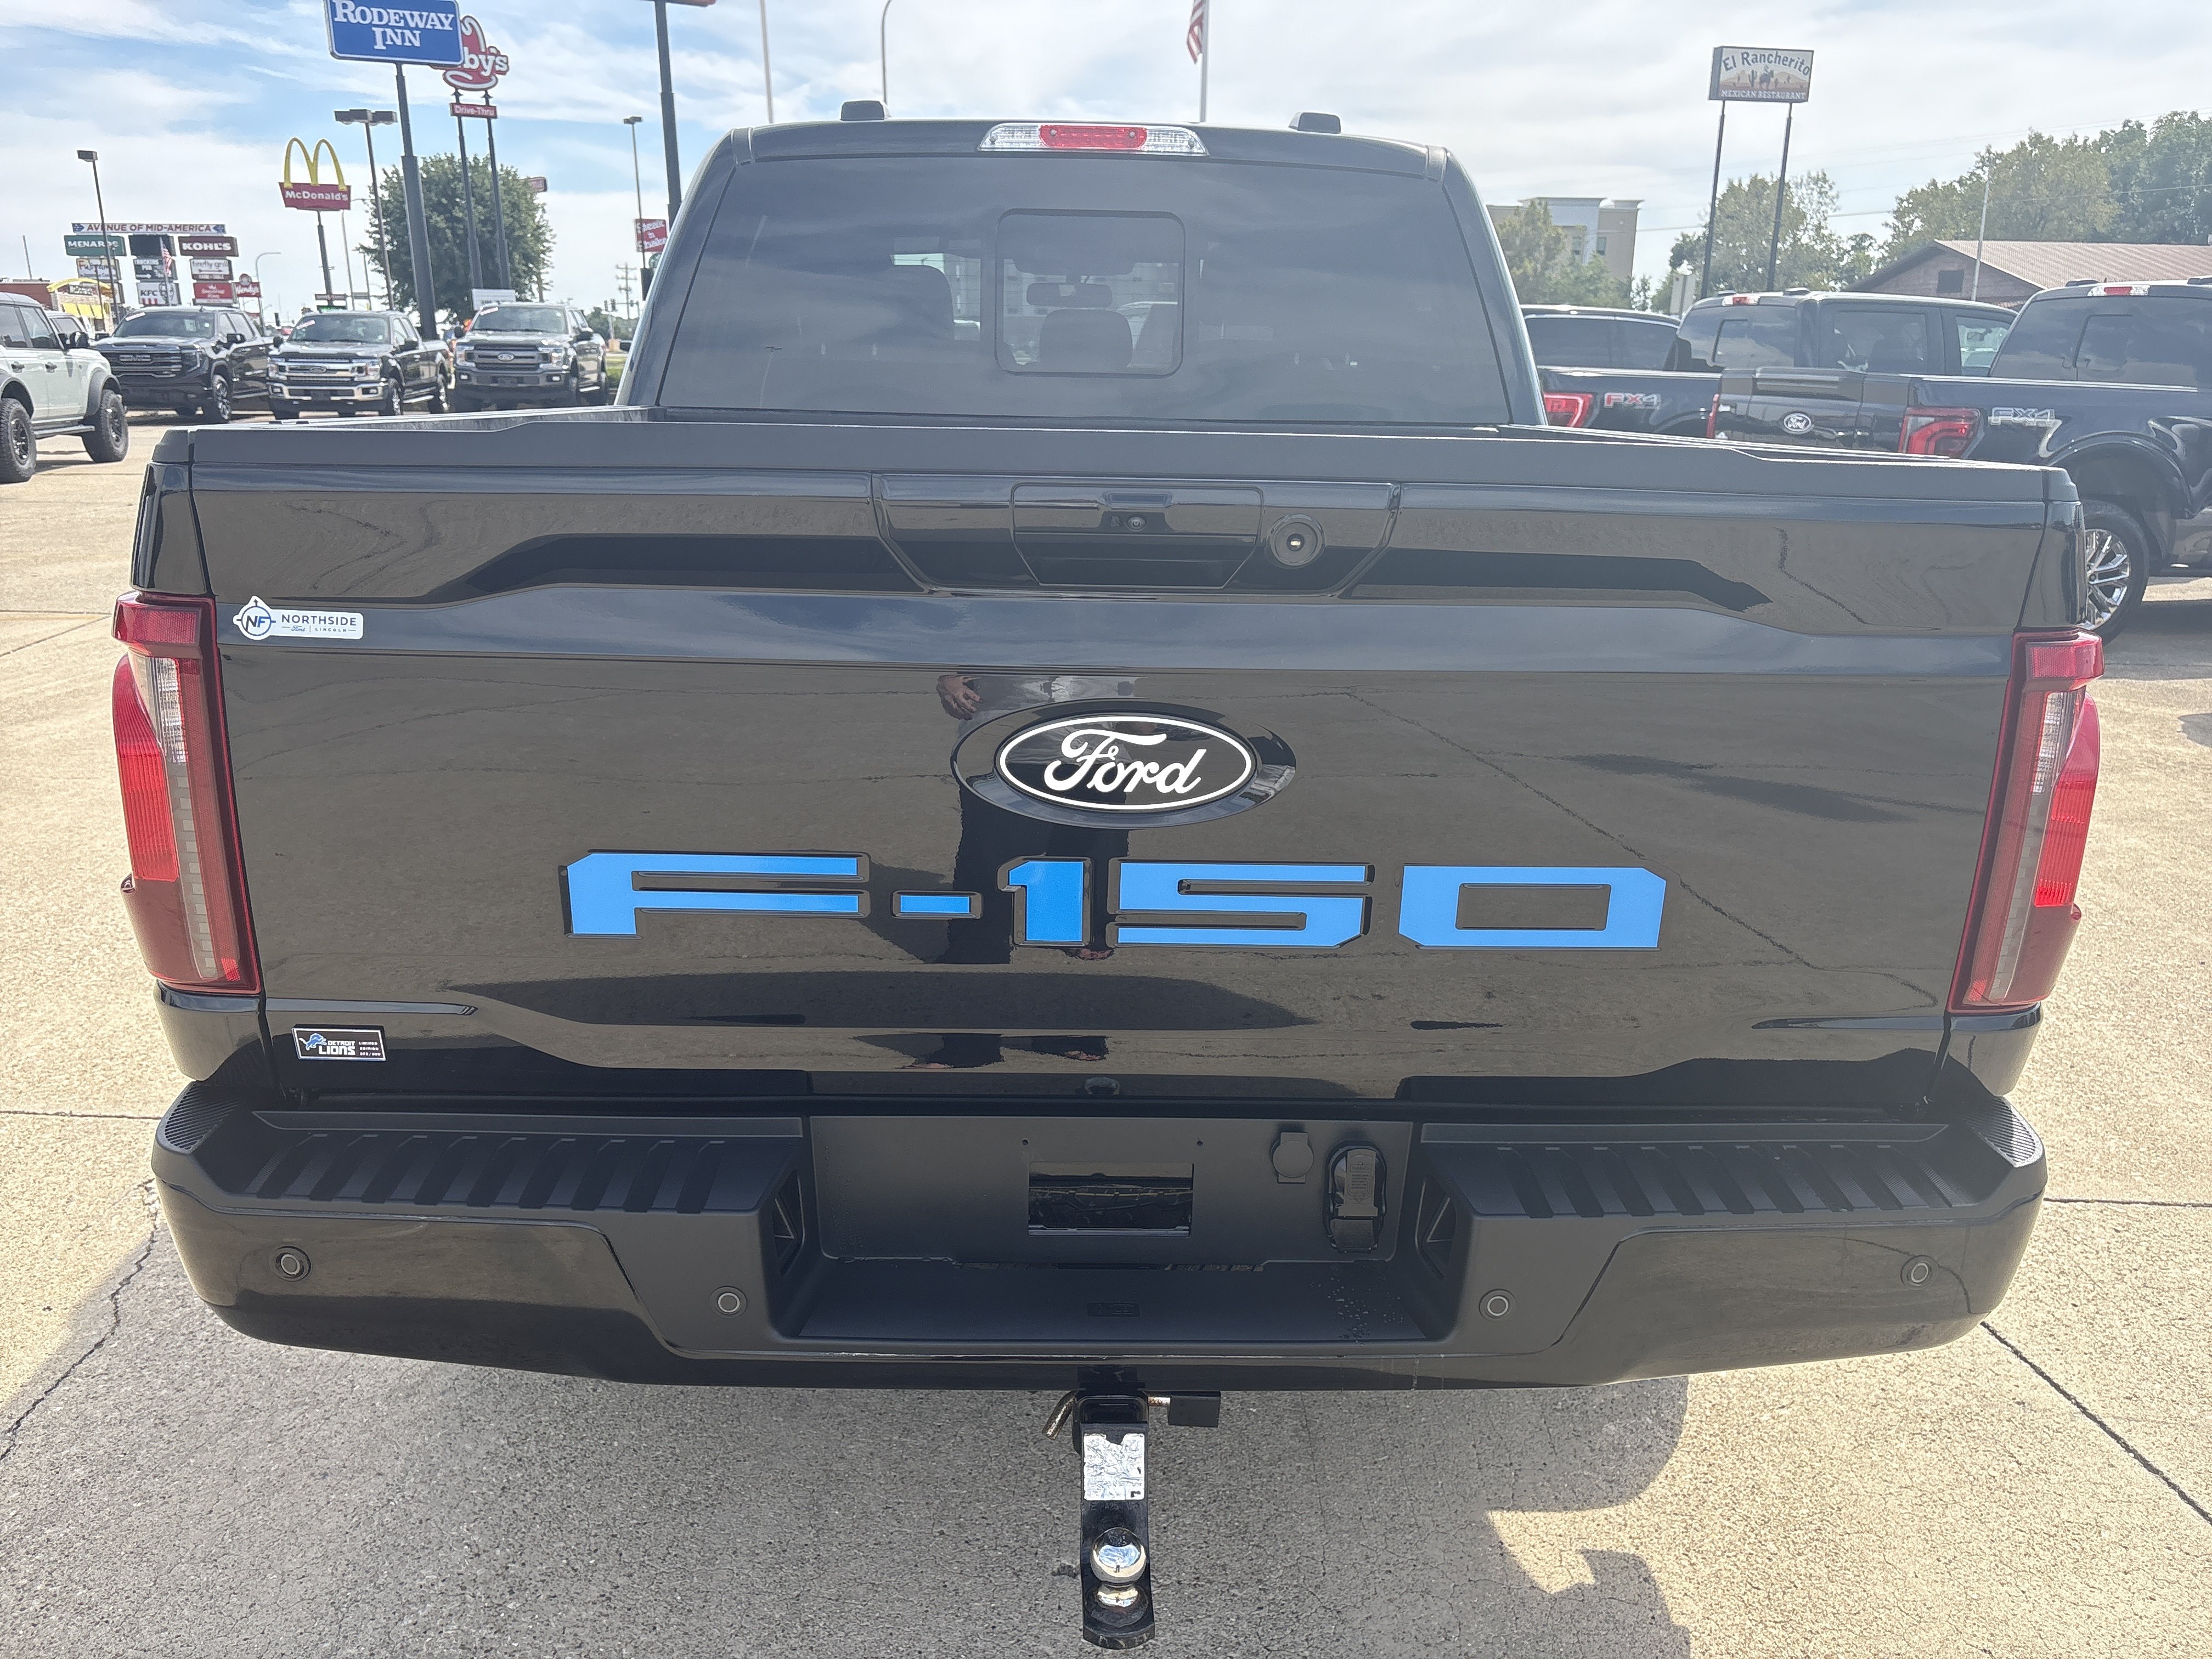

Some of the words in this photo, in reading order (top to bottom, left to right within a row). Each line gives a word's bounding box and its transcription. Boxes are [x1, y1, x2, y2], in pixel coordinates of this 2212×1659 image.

[334, 1, 455, 31] RODEWAY
[371, 27, 421, 50] INN
[460, 47, 509, 76] by's
[1723, 55, 1736, 71] El
[1740, 51, 1810, 76] Rancherito
[1721, 89, 1757, 98] MEXICAN
[1758, 91, 1806, 99] RESTAURANT
[285, 190, 348, 201] McDonald's
[182, 242, 231, 251] KOHL'S
[1604, 392, 1661, 408] FX4
[1788, 416, 1807, 428] Ford
[1990, 407, 2056, 425] FX4
[246, 615, 270, 631] NF
[281, 614, 357, 626] NORTHSIDE
[1043, 729, 1207, 794] Ford
[565, 852, 1667, 949] F-150
[318, 1045, 356, 1056] LIONS
